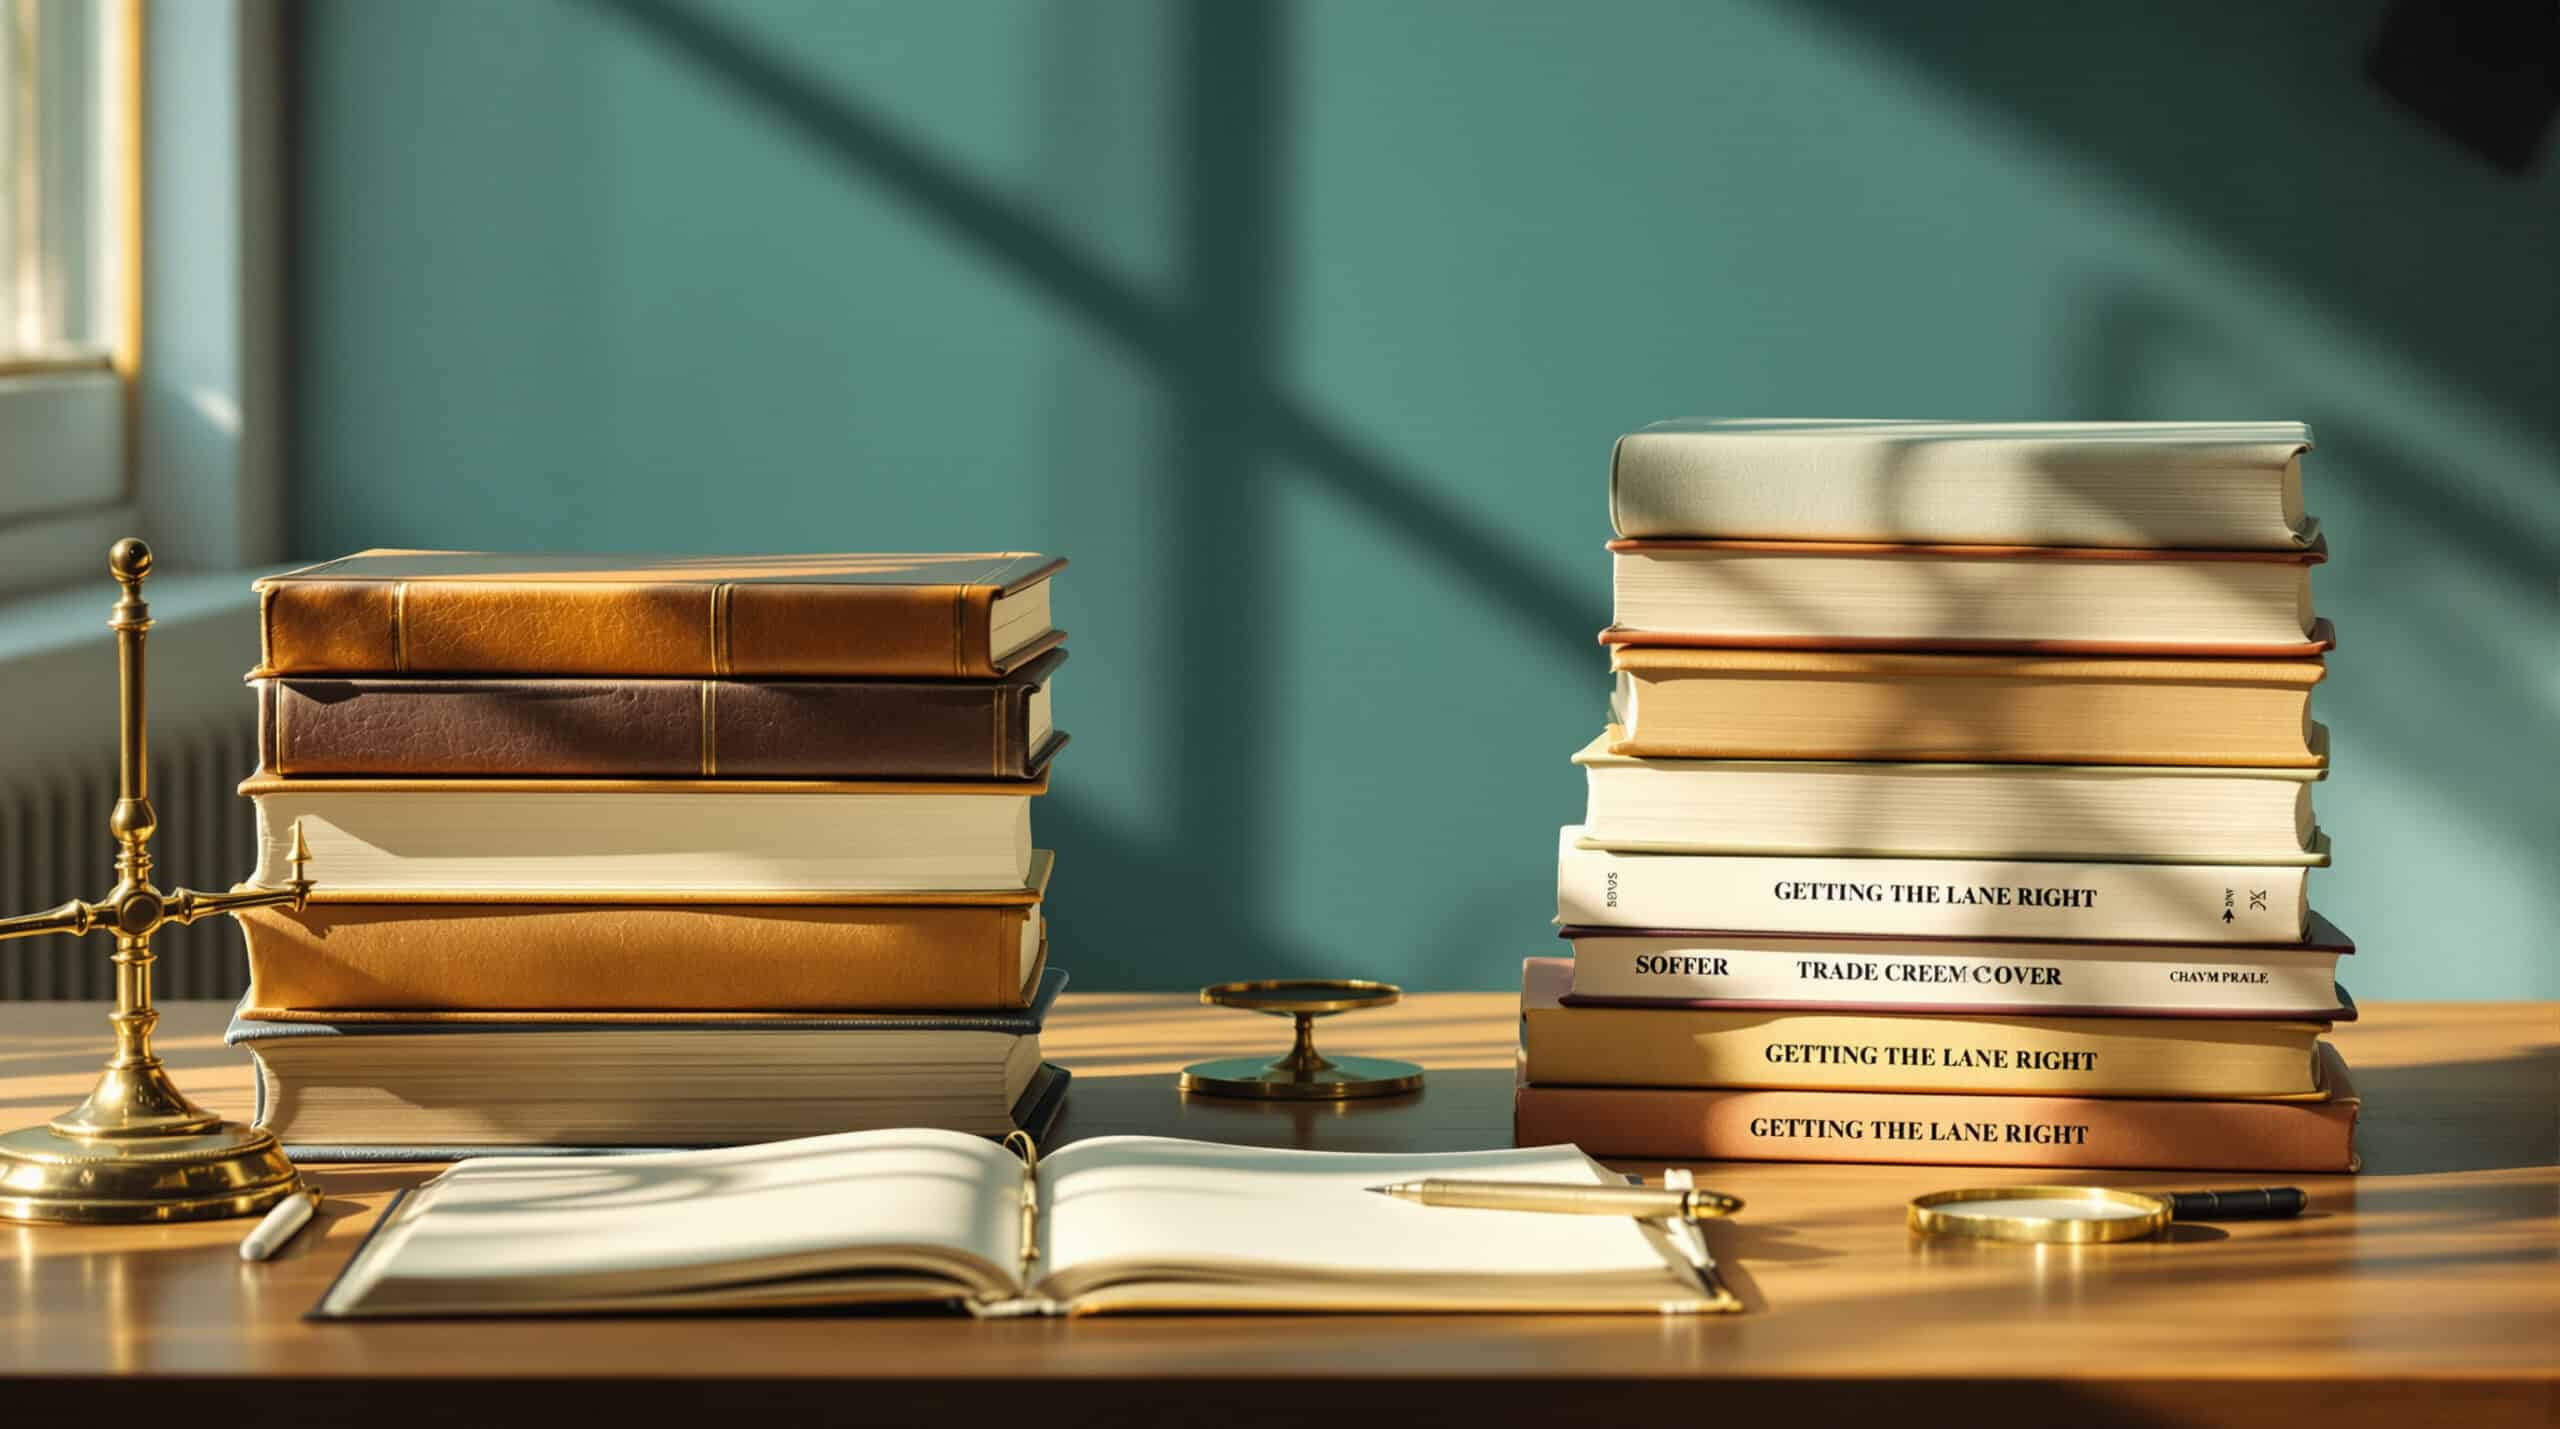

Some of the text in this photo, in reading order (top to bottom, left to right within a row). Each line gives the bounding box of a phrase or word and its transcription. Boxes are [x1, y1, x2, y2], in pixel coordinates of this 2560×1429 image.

[1774, 881, 2098, 908] GETTING THE LANE RIGHT
[1635, 955, 1729, 976] SOFFER
[1797, 960, 2063, 986] TRADE CREEM COVER
[1764, 1043, 2099, 1072] GETTING THE LANE RIGHT
[1749, 1117, 2089, 1145] GETTING THE LANE RIGHT
